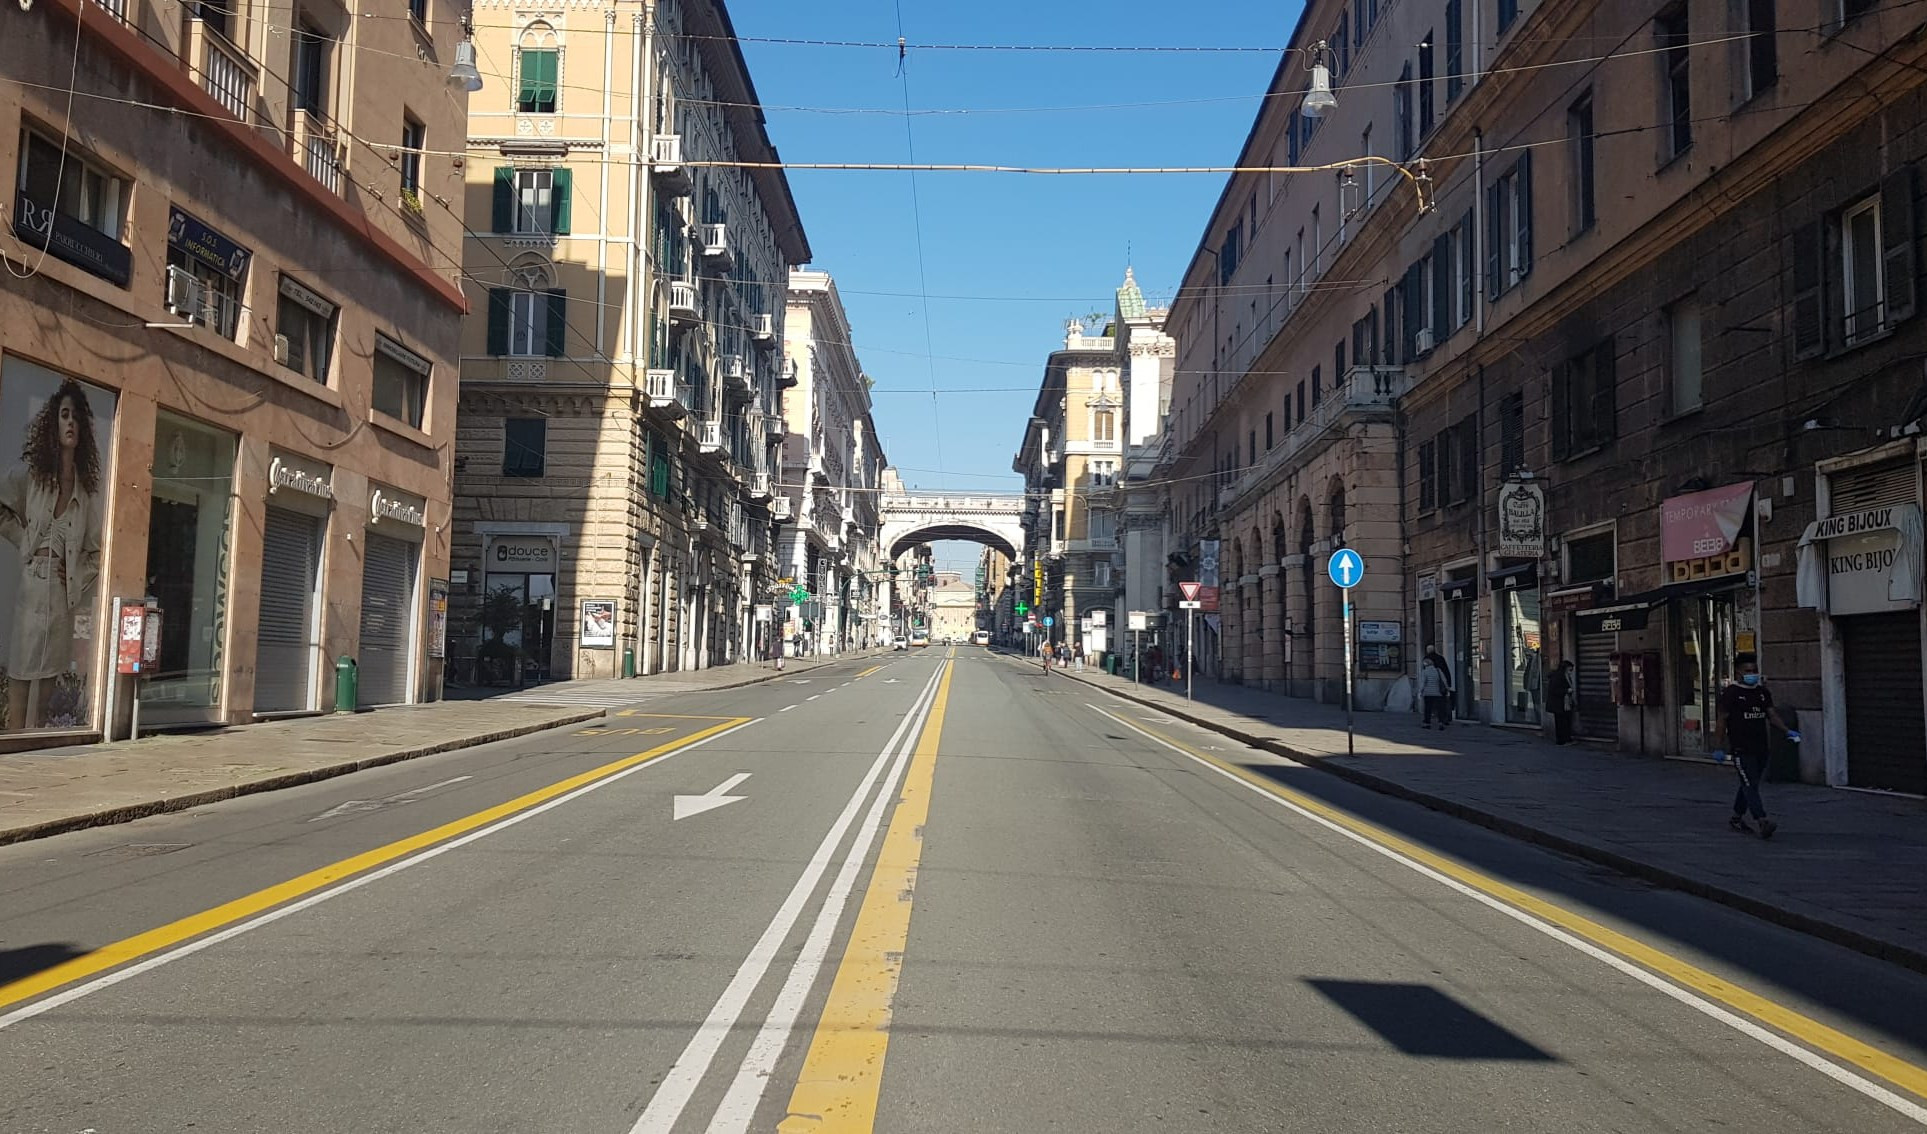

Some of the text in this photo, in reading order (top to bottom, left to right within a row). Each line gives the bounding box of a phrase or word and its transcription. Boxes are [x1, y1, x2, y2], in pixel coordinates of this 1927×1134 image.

[185, 239, 226, 268] INFORMATICA
[1815, 508, 1892, 537] KING BIJOUX
[508, 545, 548, 556] douce
[1831, 547, 1897, 575] KING BIJO
